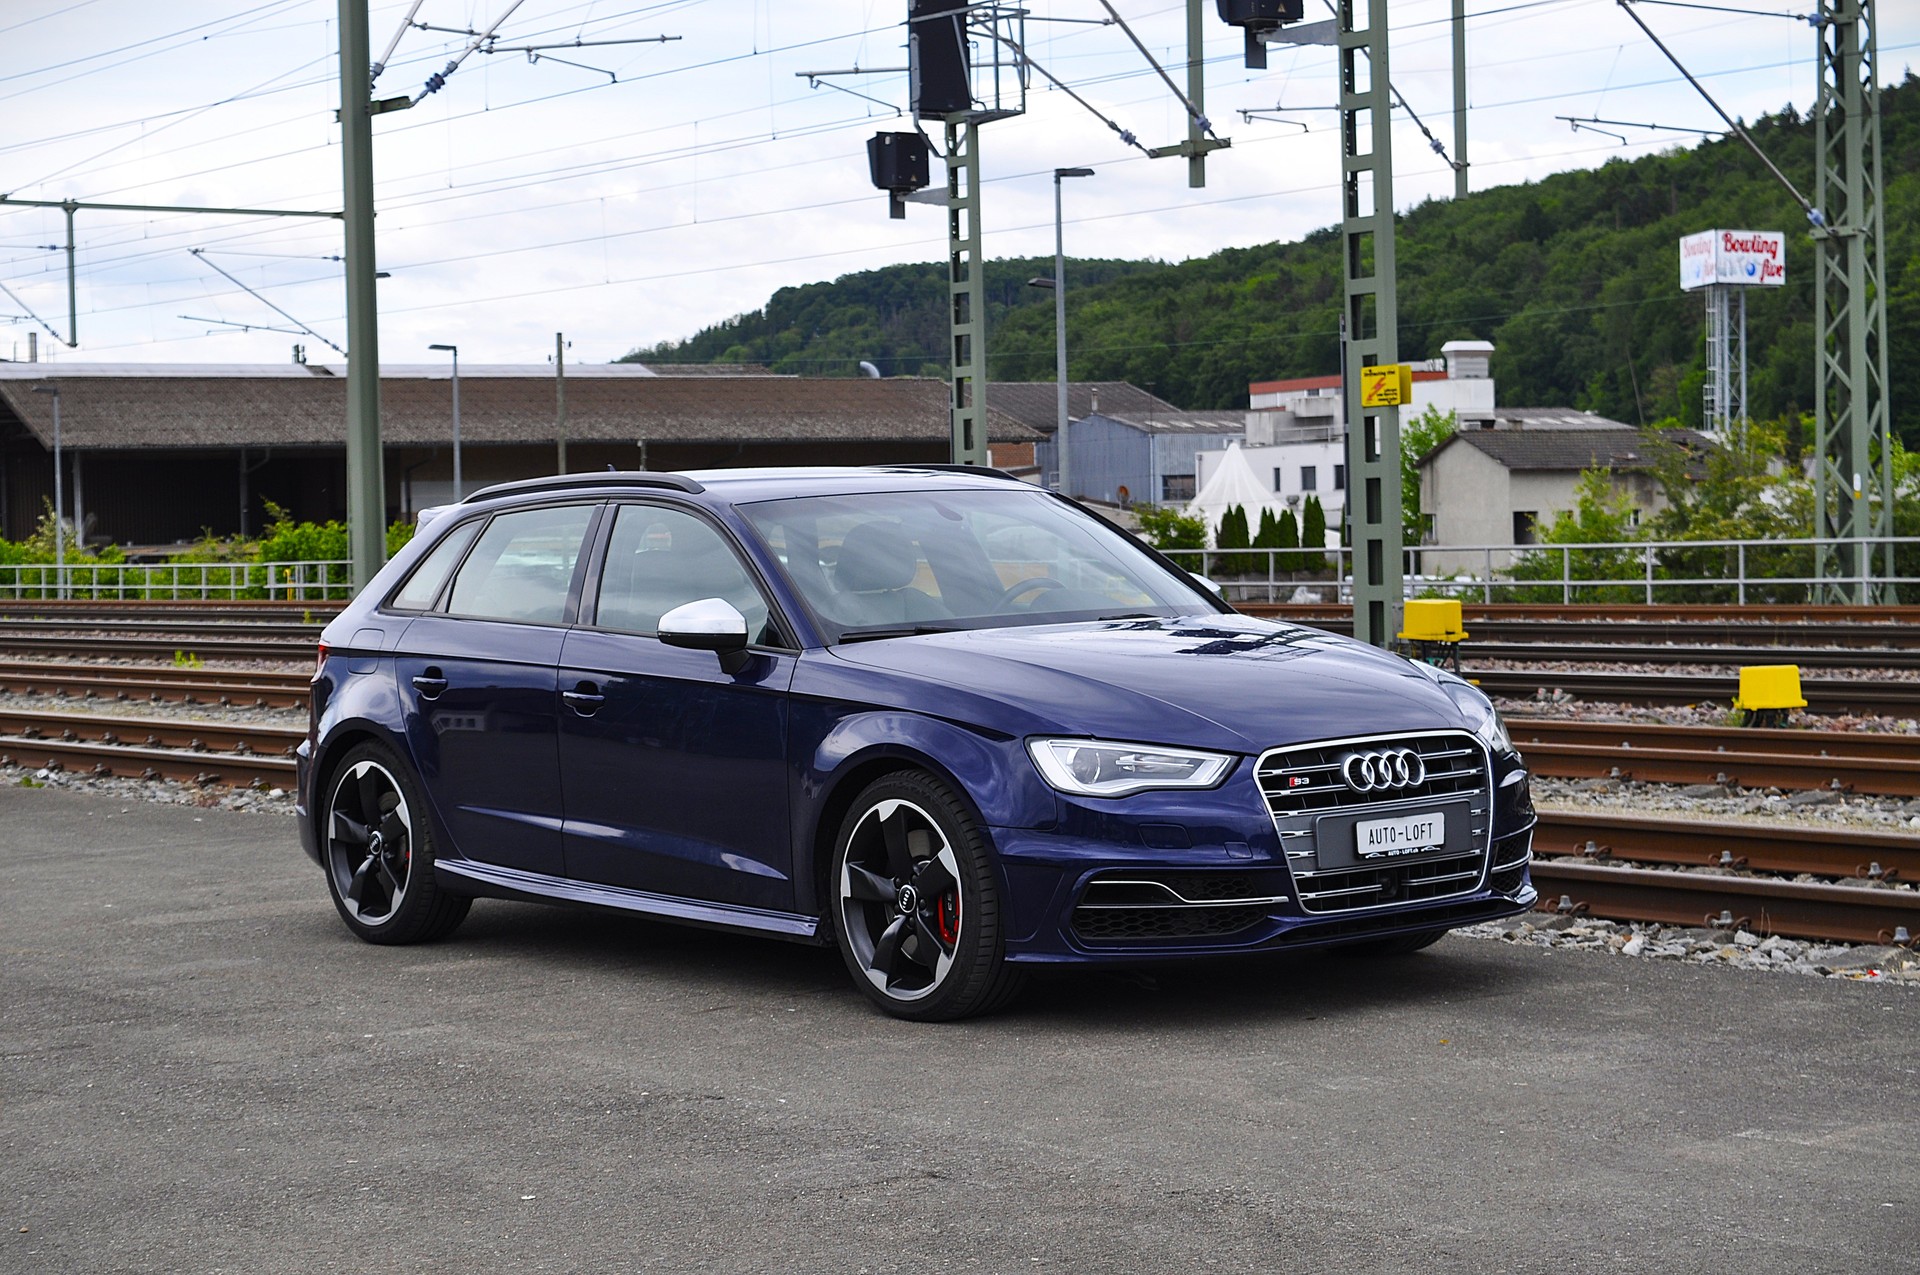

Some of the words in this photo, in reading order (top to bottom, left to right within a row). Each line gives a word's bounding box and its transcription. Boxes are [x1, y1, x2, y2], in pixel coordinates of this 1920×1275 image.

[1722, 232, 1778, 260] Bowling
[1293, 777, 1309, 785] S3
[1369, 822, 1433, 846] AUTO-LOFT
